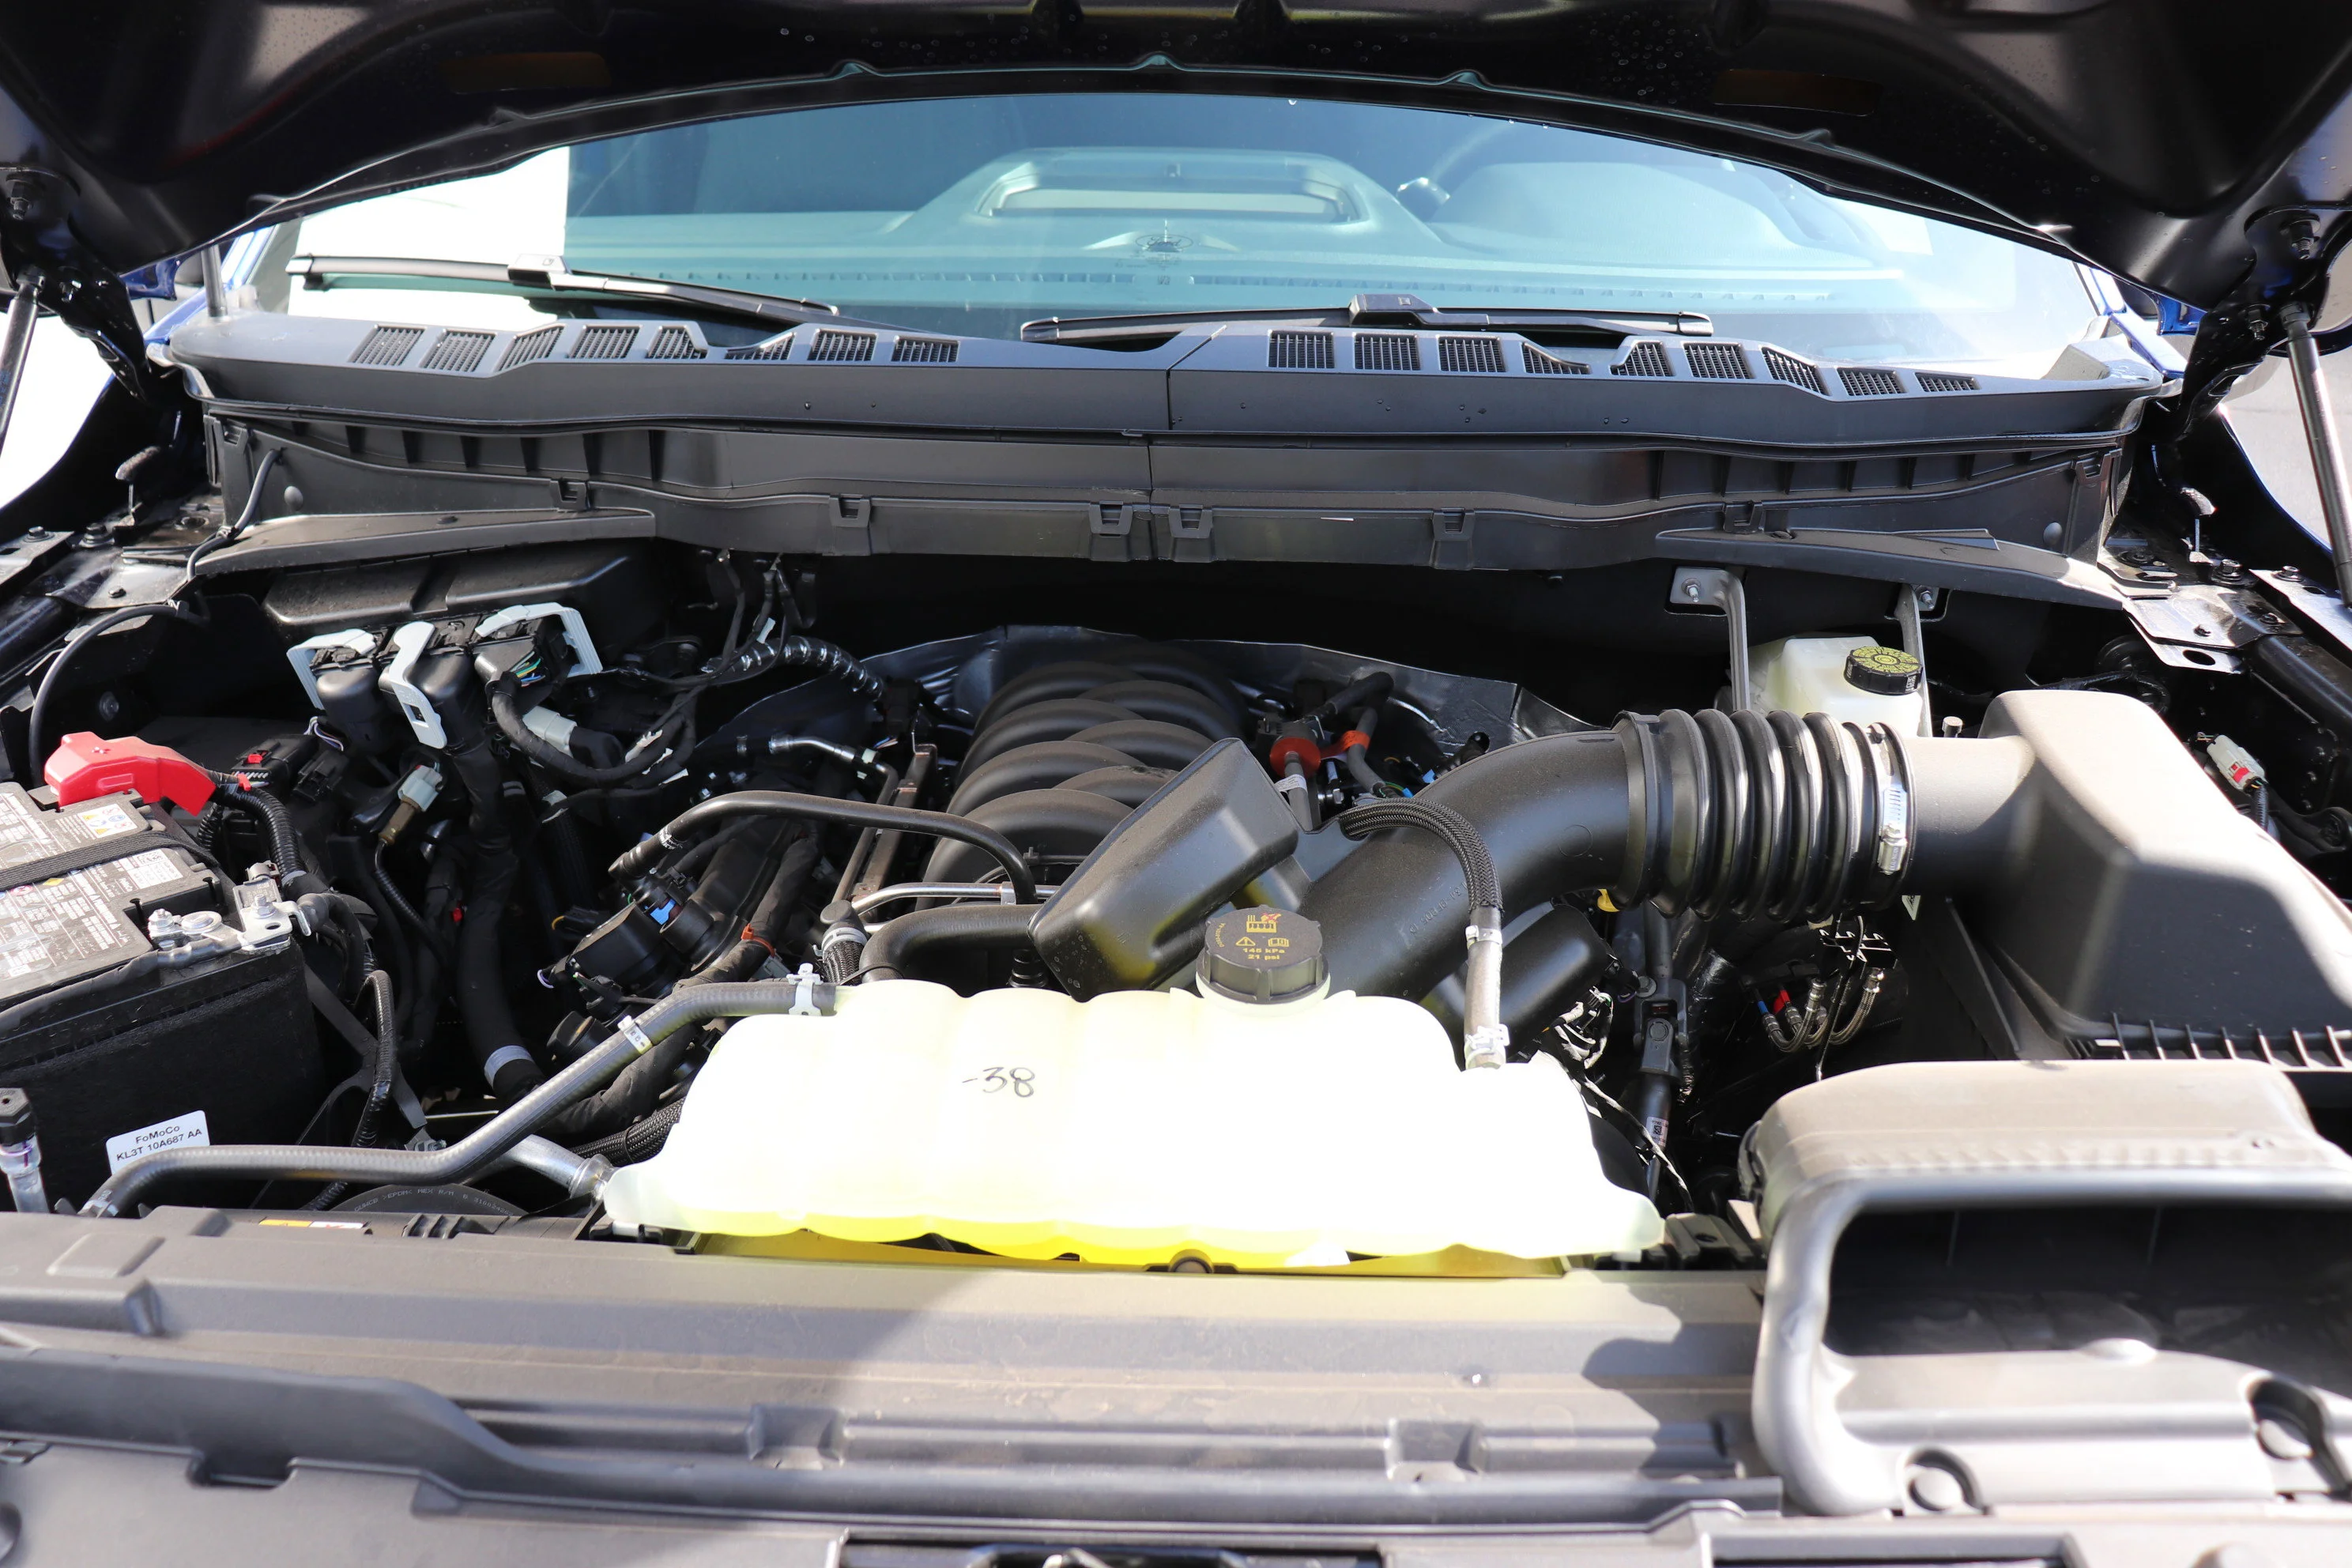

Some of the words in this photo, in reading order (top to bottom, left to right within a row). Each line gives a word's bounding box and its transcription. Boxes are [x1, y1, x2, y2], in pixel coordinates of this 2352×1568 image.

[116, 1147, 143, 1162] KL3T
[148, 1133, 184, 1151] 10A687
[187, 1129, 202, 1139] AA
[135, 1125, 180, 1144] FoMoCo
